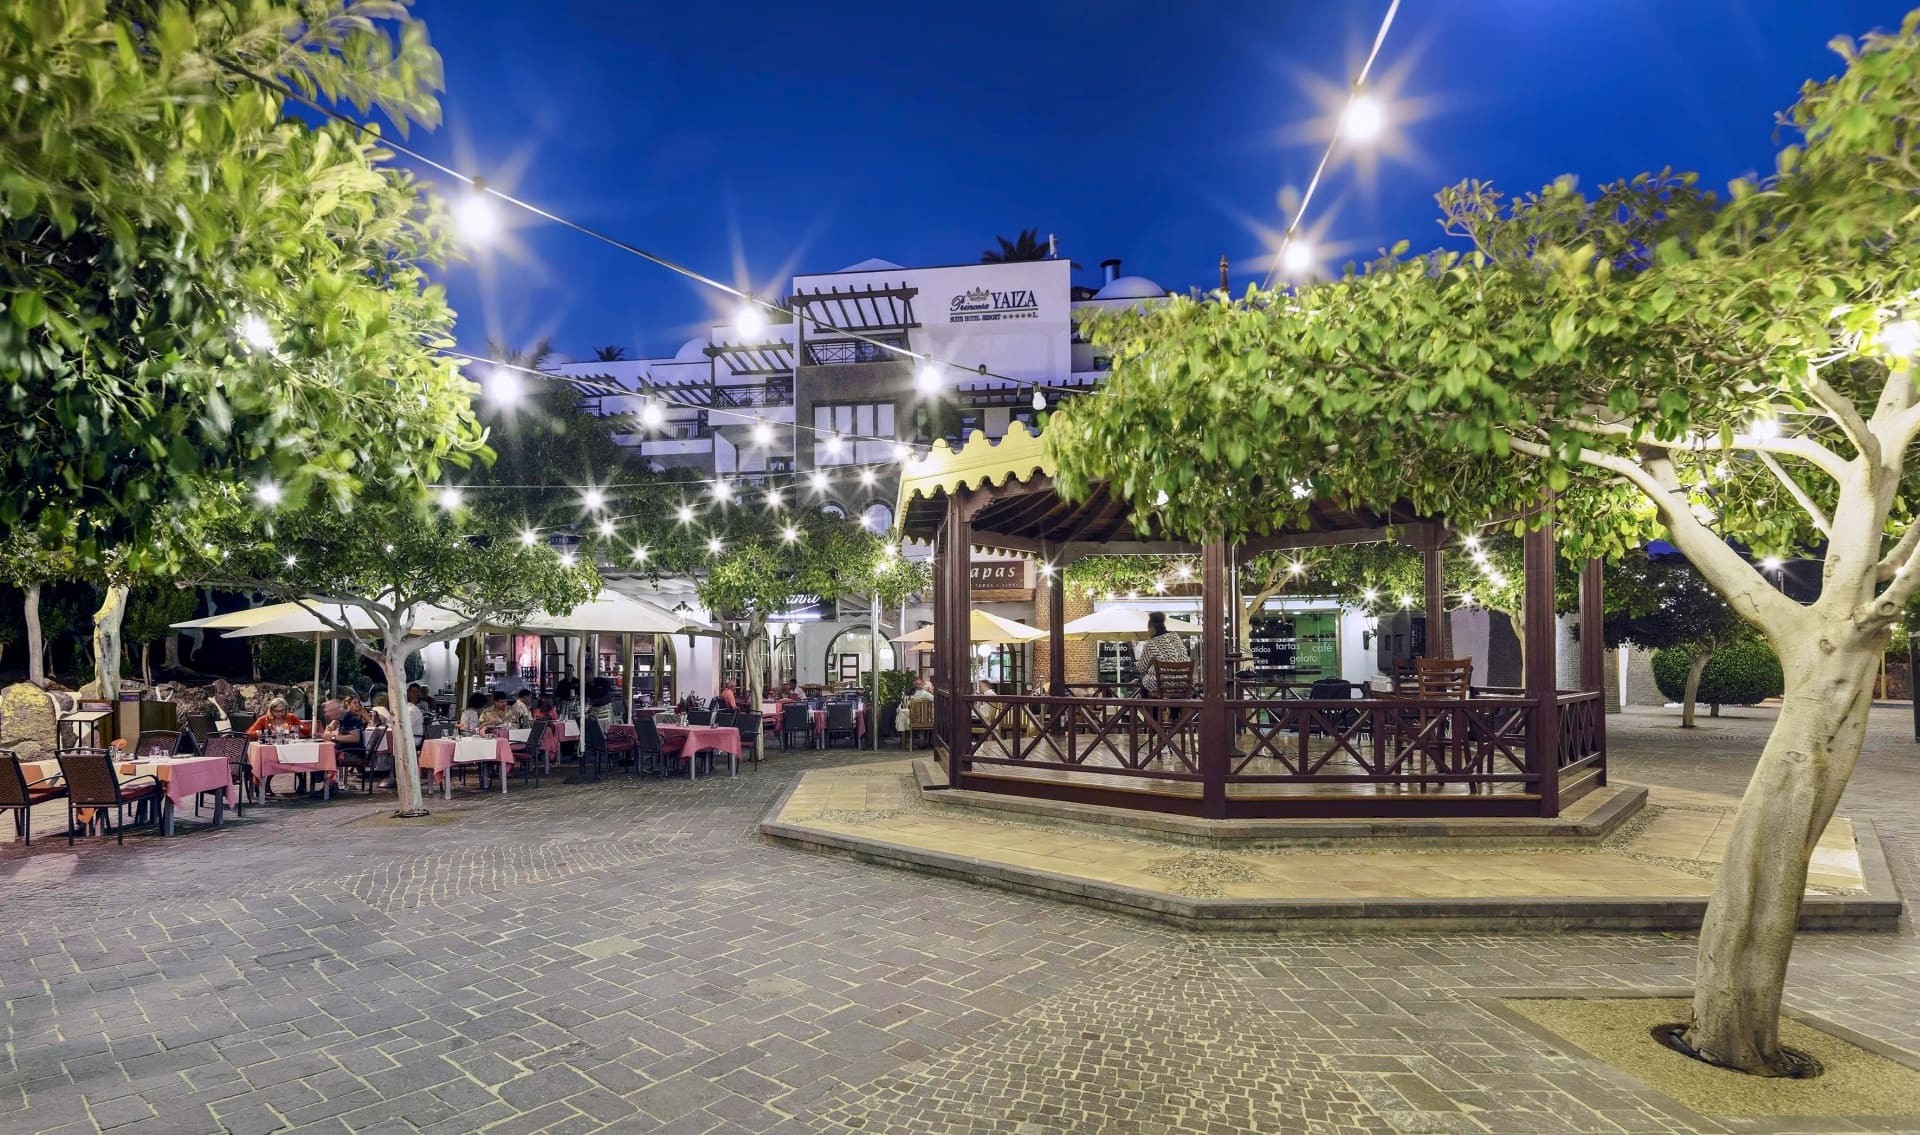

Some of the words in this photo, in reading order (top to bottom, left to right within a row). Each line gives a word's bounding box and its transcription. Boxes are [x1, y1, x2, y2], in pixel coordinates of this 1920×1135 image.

[991, 290, 1038, 309] YAIZA
[970, 566, 1016, 580] apas
[1251, 645, 1271, 653] atidos
[1275, 642, 1300, 651] tartas
[1312, 642, 1333, 652] café
[1289, 653, 1318, 665] gelato
